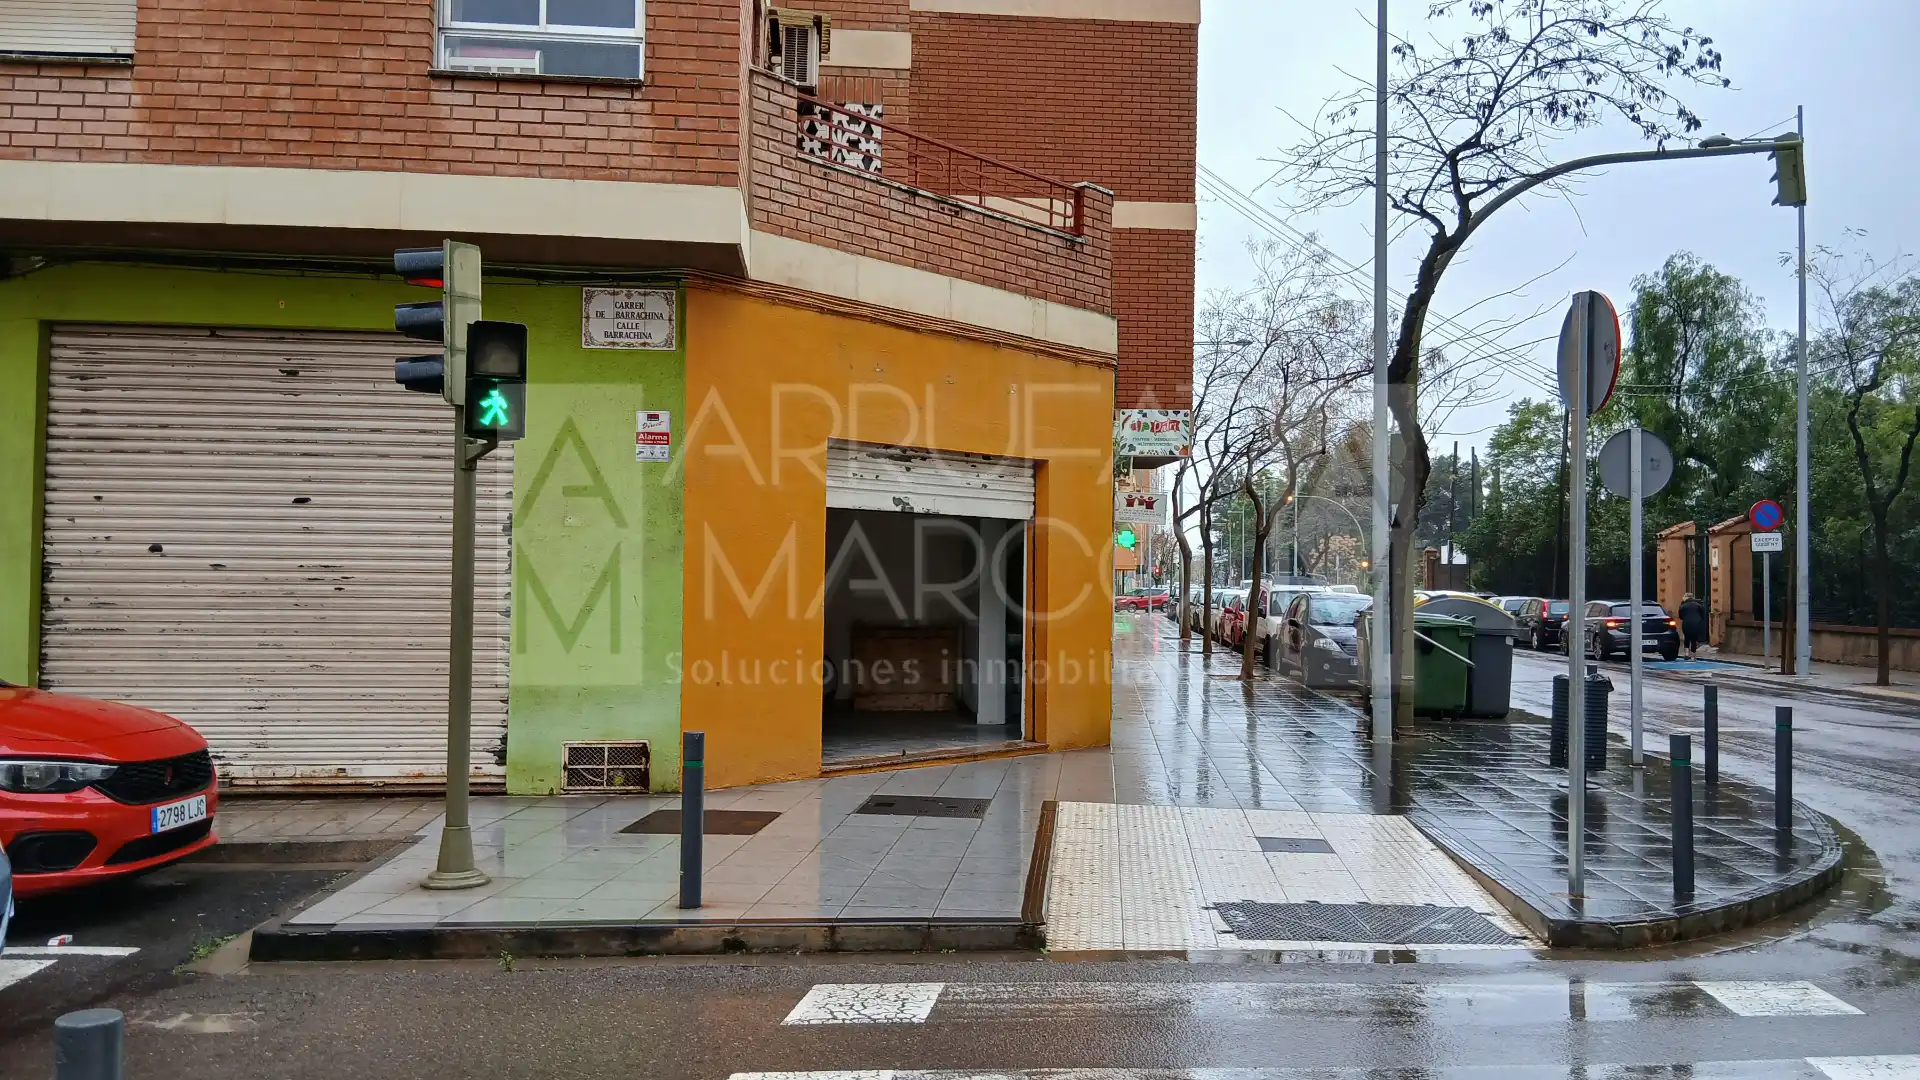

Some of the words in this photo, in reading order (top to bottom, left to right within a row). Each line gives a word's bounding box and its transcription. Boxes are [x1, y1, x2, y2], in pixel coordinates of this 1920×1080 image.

[614, 301, 645, 310] CARRER
[615, 311, 665, 320] BARRACHINA
[616, 322, 640, 330] CALLE
[604, 330, 653, 340] BARRACHINA
[638, 433, 668, 441] Alarma
[160, 804, 186, 828] 2798
[188, 799, 205, 820] LJC
